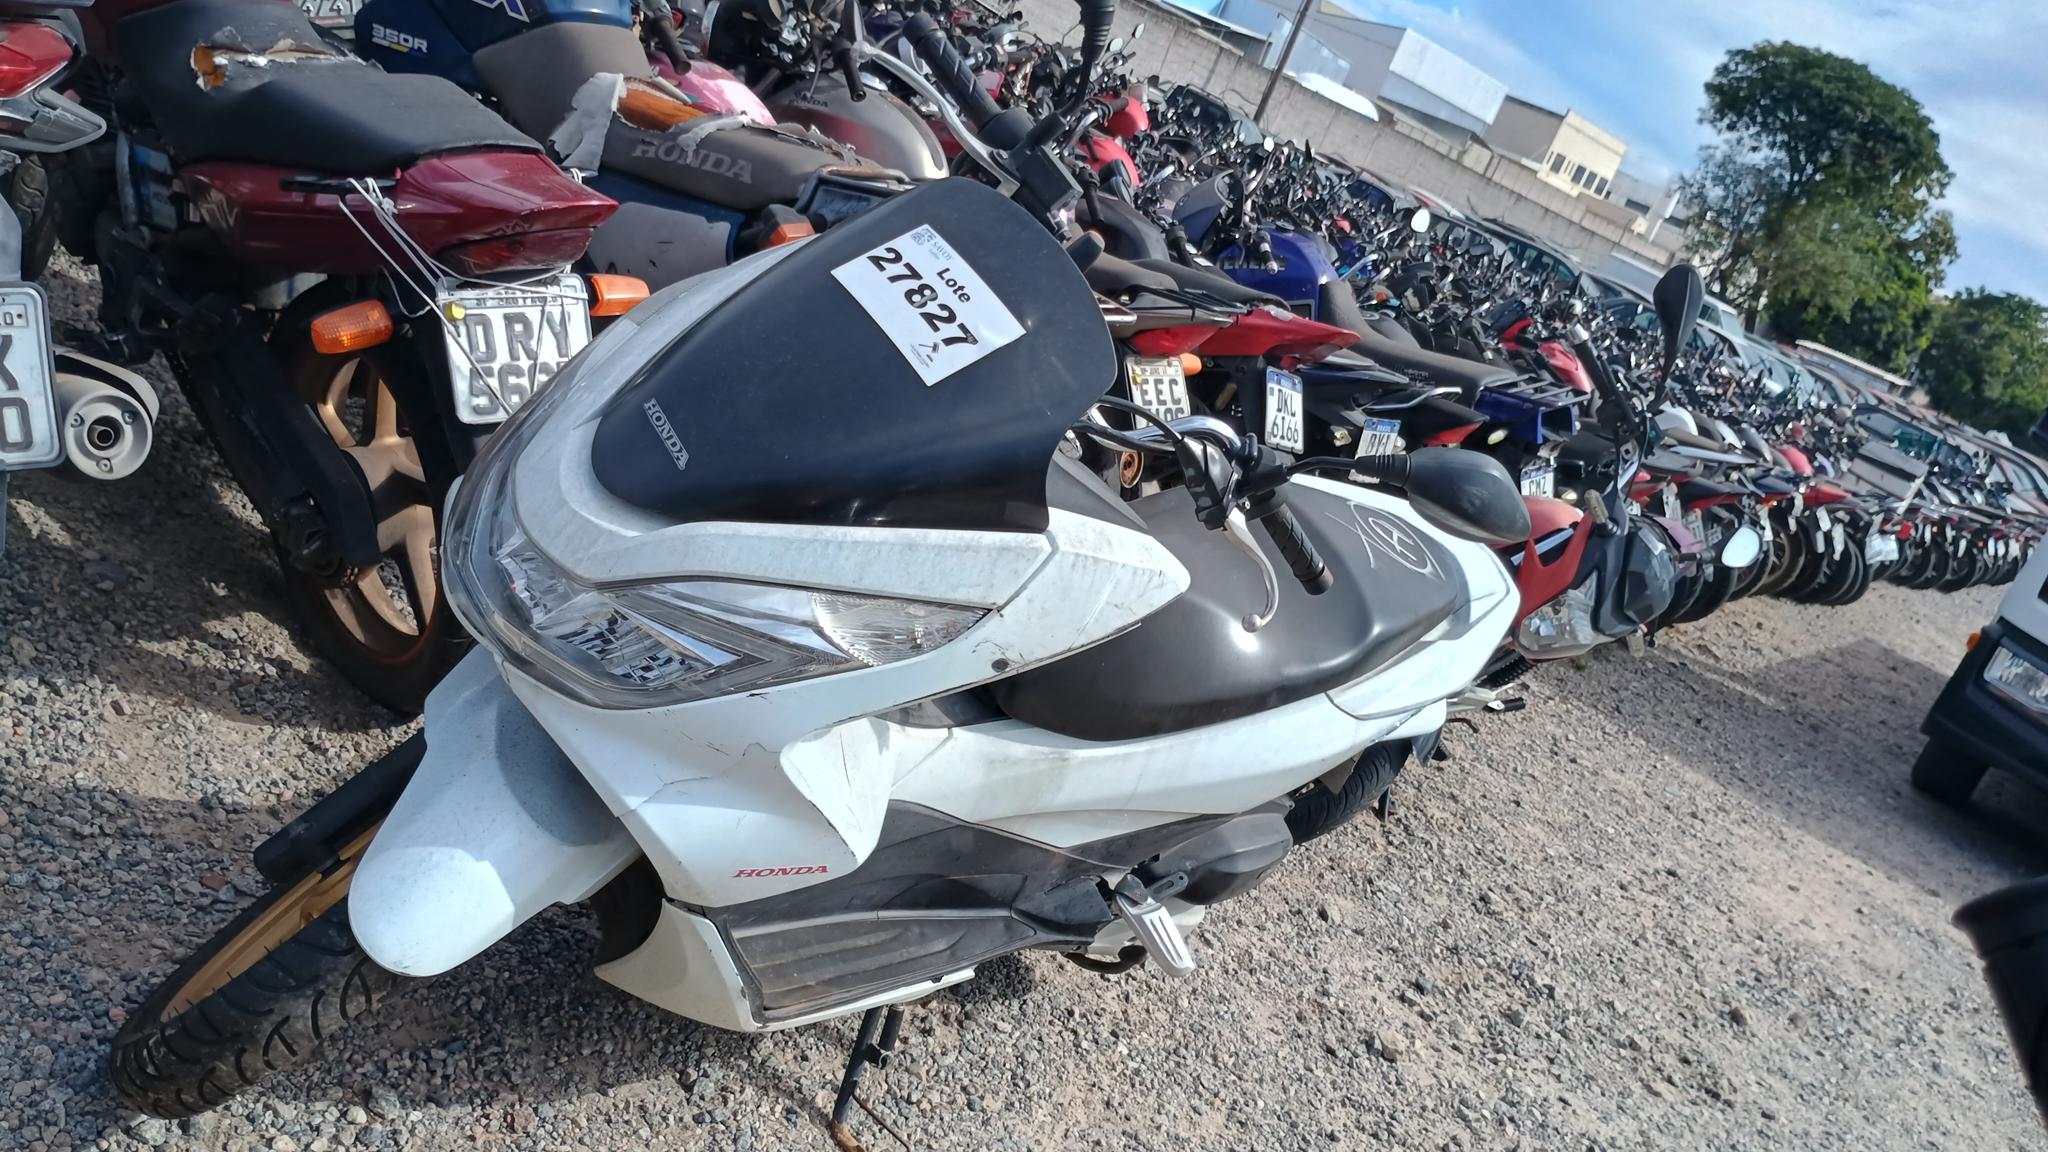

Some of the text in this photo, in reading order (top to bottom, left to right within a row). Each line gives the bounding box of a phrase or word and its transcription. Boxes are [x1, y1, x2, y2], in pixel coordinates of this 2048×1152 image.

[371, 23, 428, 53] 350R
[866, 247, 979, 347] 27827
[936, 267, 972, 303] Lote
[464, 311, 571, 363] DRY
[1139, 378, 1182, 407] EEC
[1276, 388, 1296, 418] DKL
[643, 397, 688, 469] HONDA
[731, 865, 829, 878] HONDA
